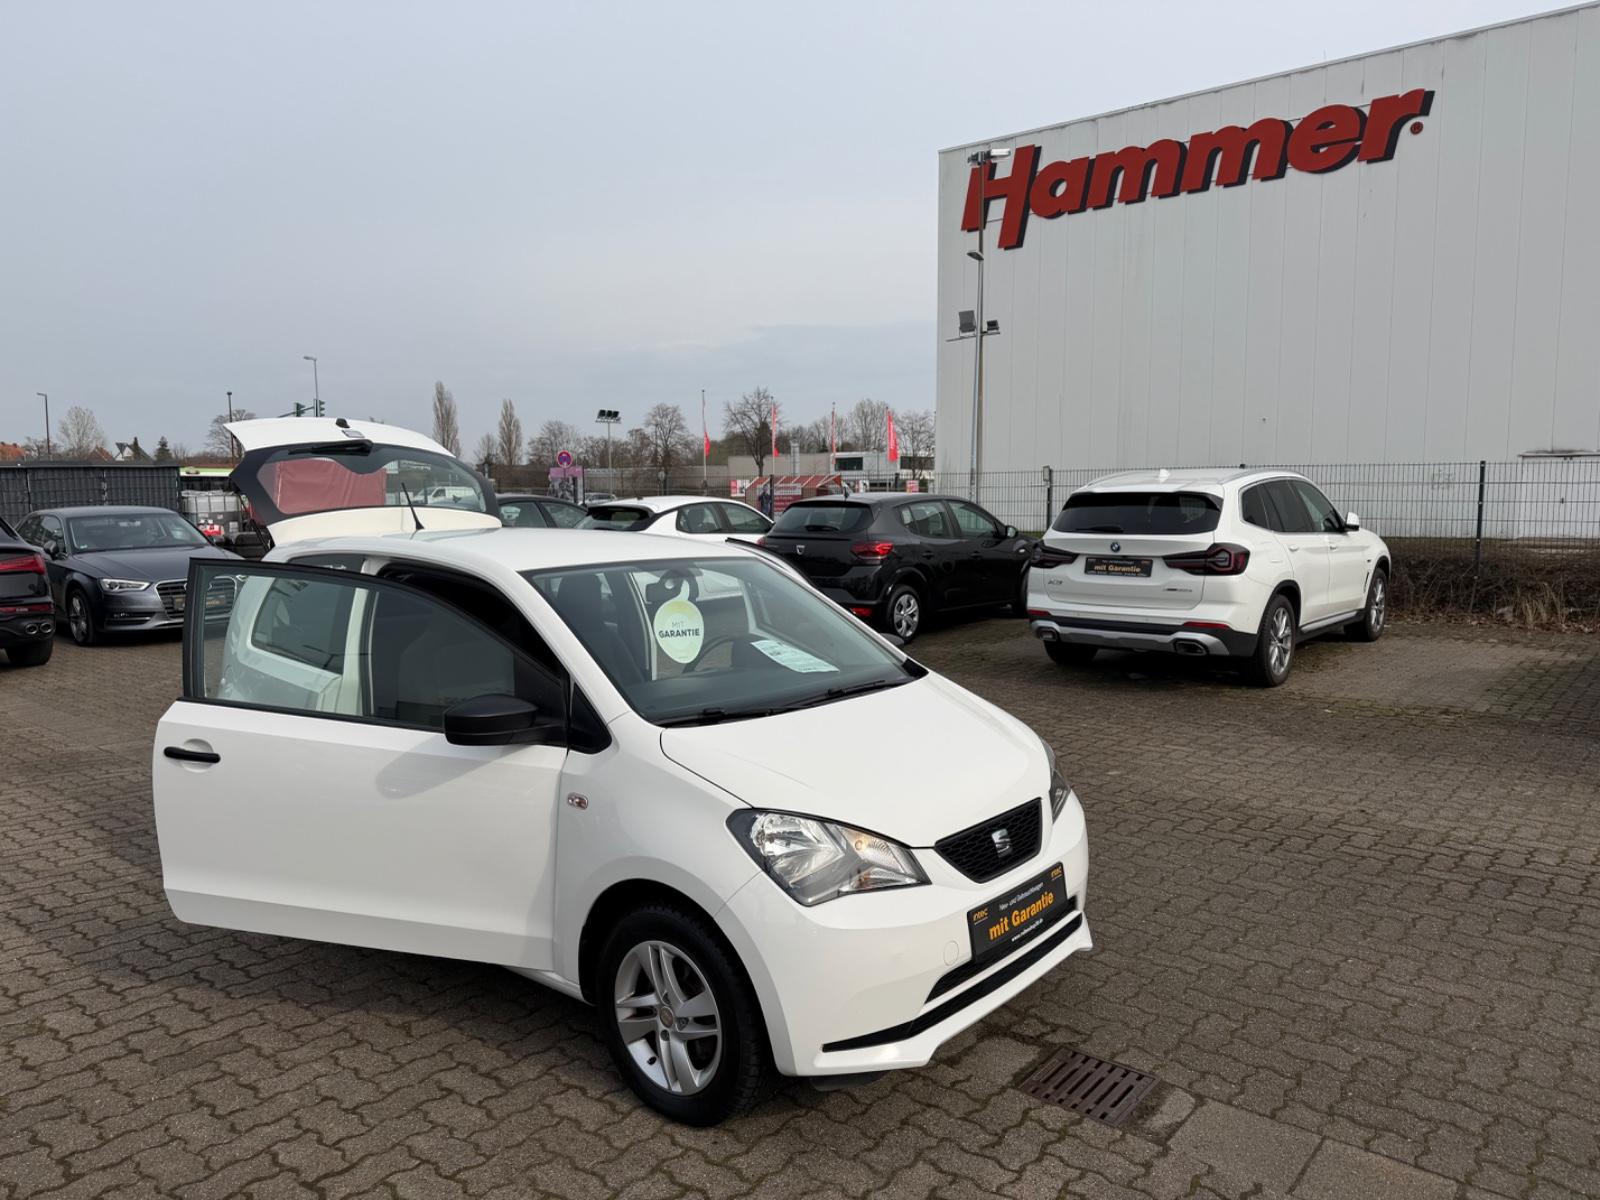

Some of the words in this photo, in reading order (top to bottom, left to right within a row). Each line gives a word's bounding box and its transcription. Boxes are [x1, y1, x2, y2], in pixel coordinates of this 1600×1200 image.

[961, 87, 1430, 250] Hammer
[1108, 564, 1141, 573] Garantie
[672, 620, 684, 629] MIT
[658, 628, 700, 639] GARANTIE
[988, 916, 1009, 941] mit
[1011, 891, 1055, 928] Garantie
